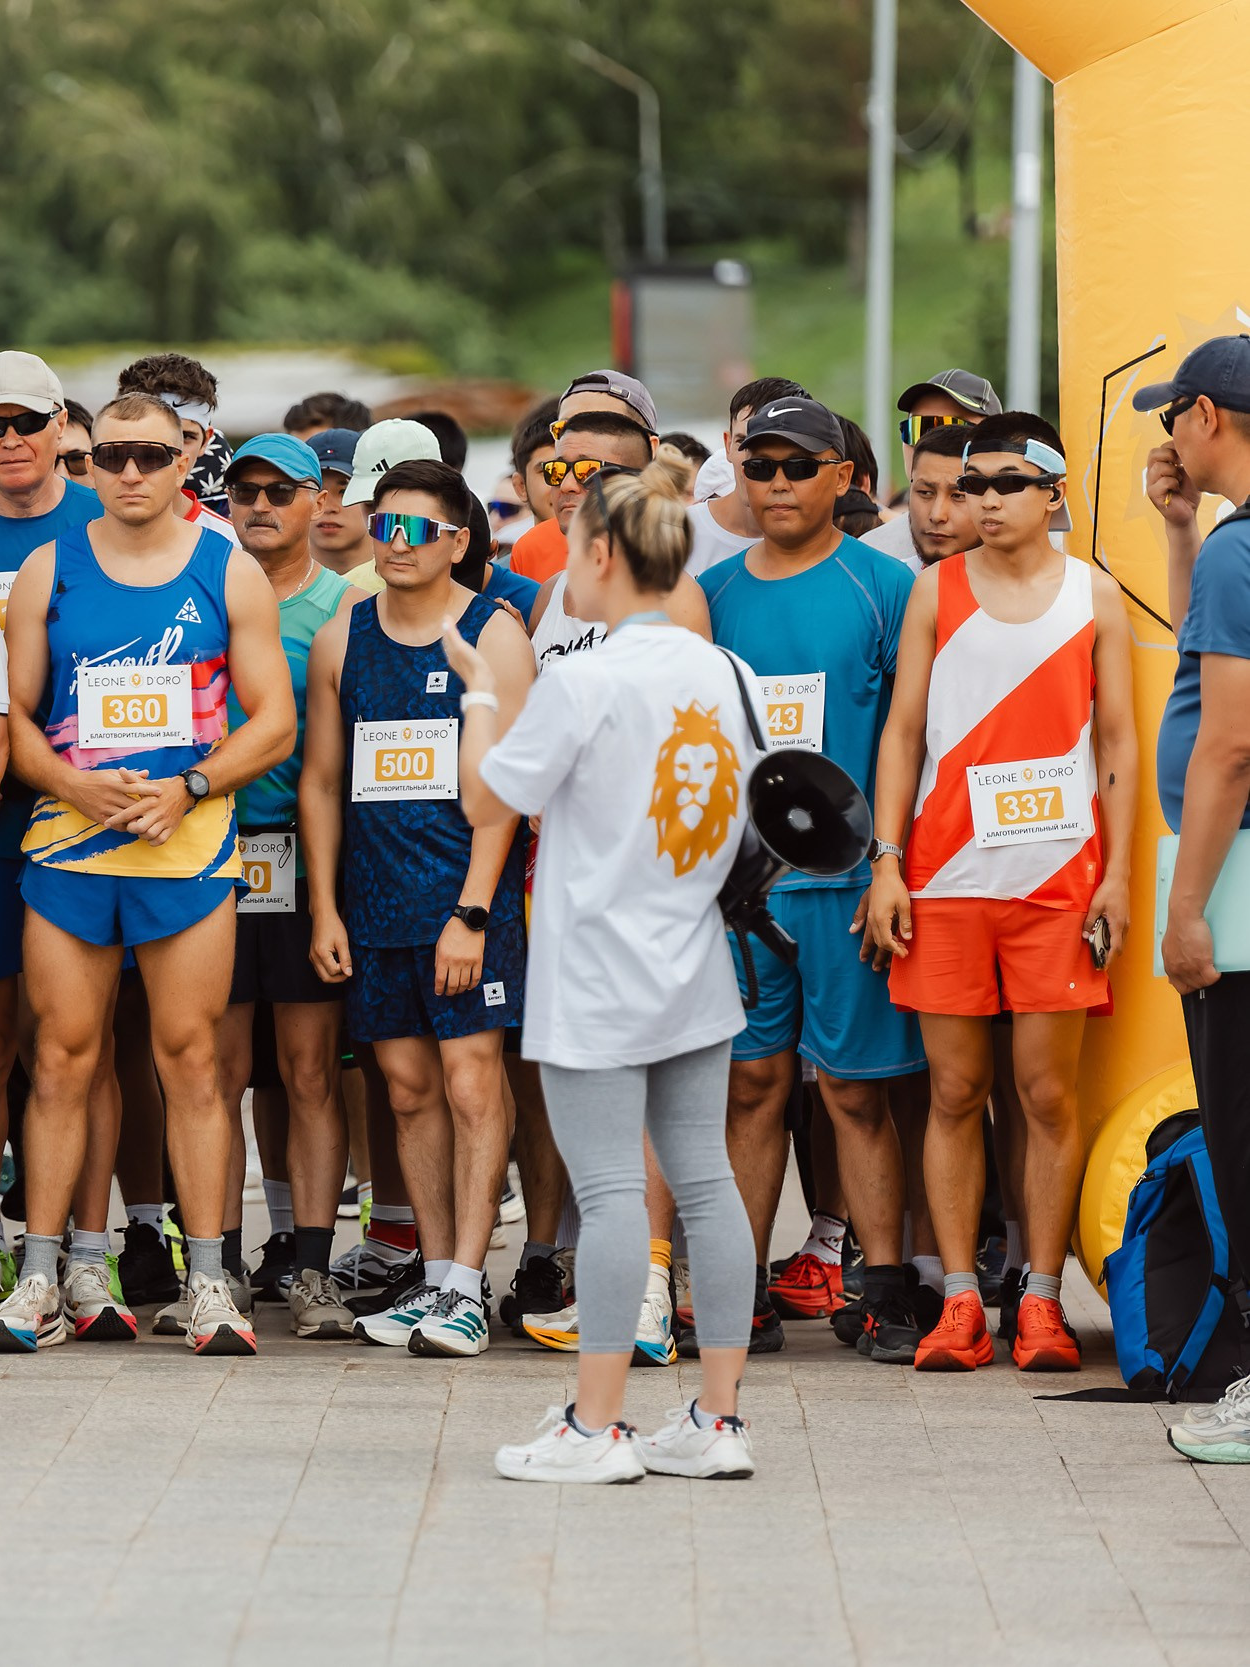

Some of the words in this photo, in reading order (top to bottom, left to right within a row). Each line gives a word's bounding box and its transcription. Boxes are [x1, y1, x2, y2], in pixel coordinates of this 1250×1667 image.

[87, 677, 126, 687] LEONE
[146, 675, 181, 686] D'ORO
[788, 684, 817, 695] D'ORO
[108, 698, 161, 724] 360
[767, 706, 798, 732] 43
[90, 731, 161, 739] БЛАГОТВОРИТЕЛЬНЫЙ
[363, 731, 398, 742] LEONE
[416, 729, 449, 740] D'ORO
[380, 751, 428, 778] 500
[978, 772, 1018, 786] LEONE
[1038, 766, 1074, 780] D'ORO
[362, 784, 427, 793] БЛАГОТВОРИТЕЛЬНЫЙ
[1002, 791, 1055, 821] 337
[986, 823, 1059, 838] БЛАГОТВОРИТЕЛЬНЫЙ
[1060, 822, 1079, 830] ЗАБЕГ
[251, 843, 285, 853] D'ORO
